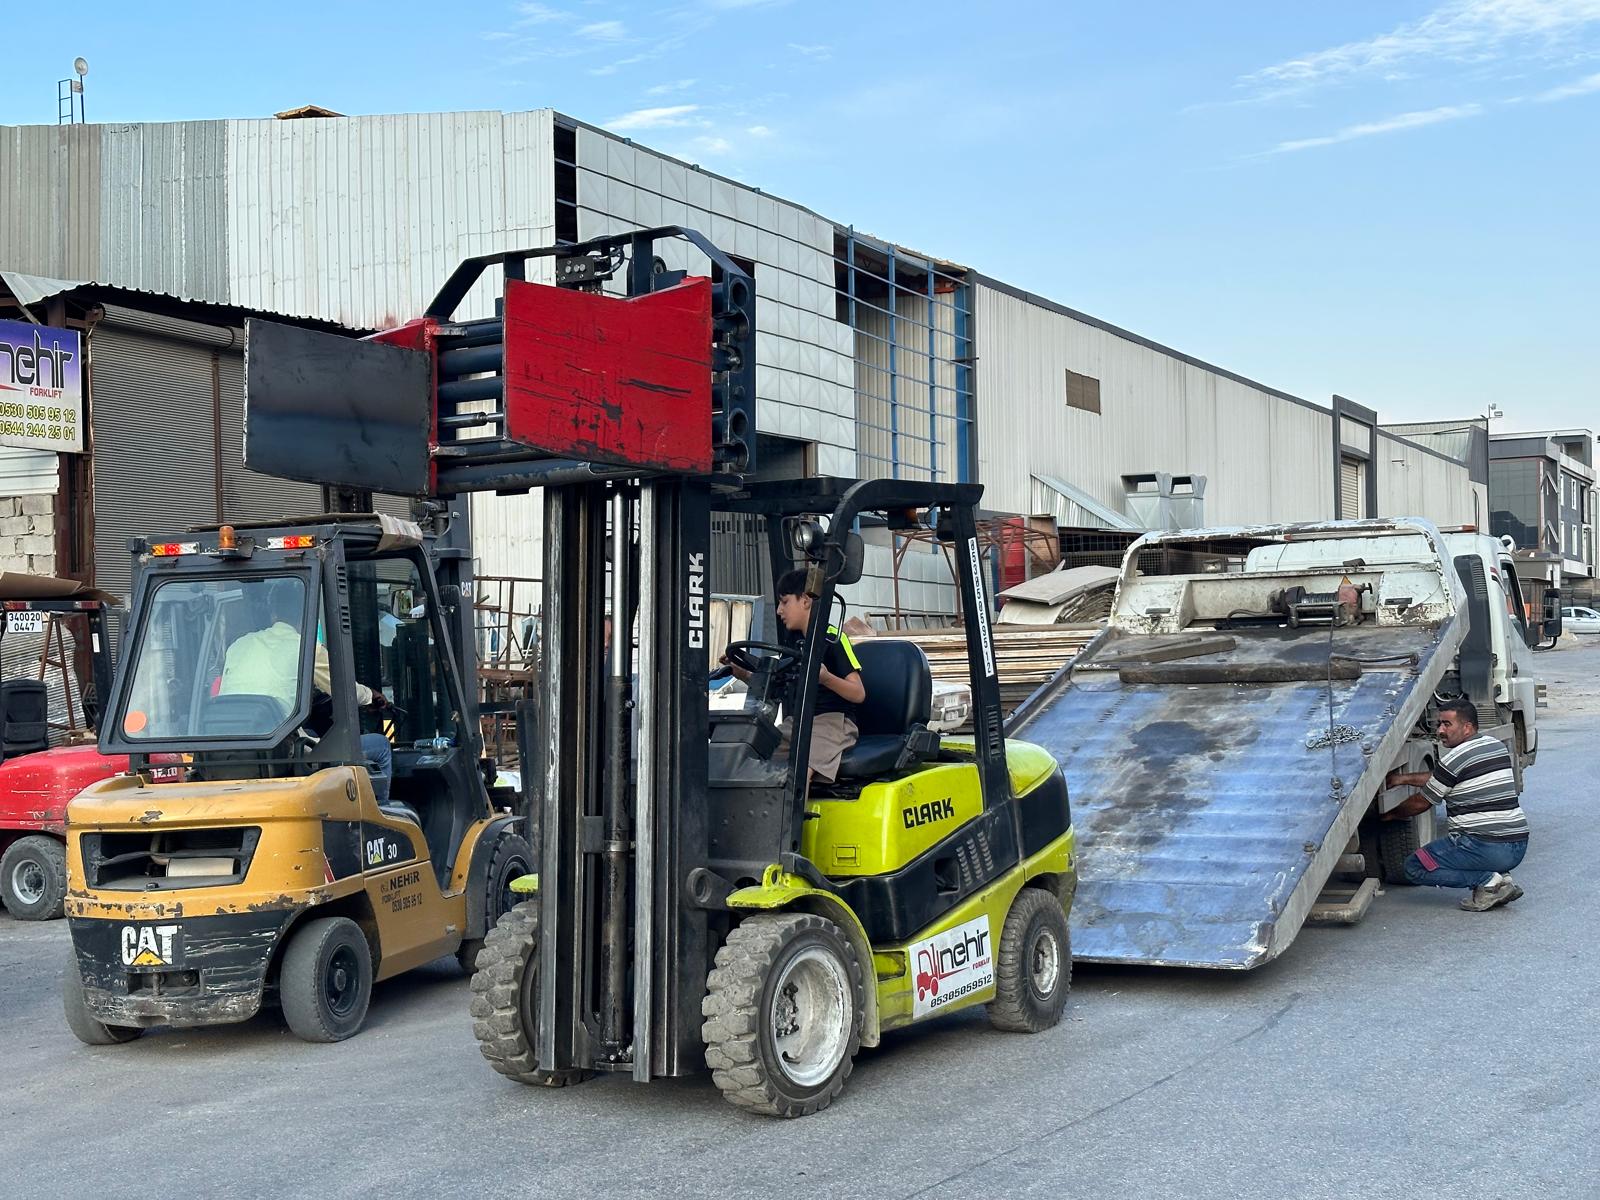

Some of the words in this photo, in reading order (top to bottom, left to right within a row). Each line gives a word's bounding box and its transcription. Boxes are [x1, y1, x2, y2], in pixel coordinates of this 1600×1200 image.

[30, 387, 62, 399] FORKLIFT
[27, 405, 46, 420] 505
[48, 407, 61, 421] 95
[63, 409, 76, 423] 12
[27, 423, 46, 437] 244
[48, 426, 61, 439] 25
[63, 427, 75, 440] 01
[461, 581, 472, 597] CAT
[689, 552, 704, 649] CLARK
[8, 612, 41, 622] 340020
[14, 622, 35, 632] 0447
[903, 797, 955, 829] CLARK
[366, 838, 385, 865] CAT
[387, 843, 398, 860] 30
[121, 925, 178, 966] CAT
[939, 929, 989, 974] nehir
